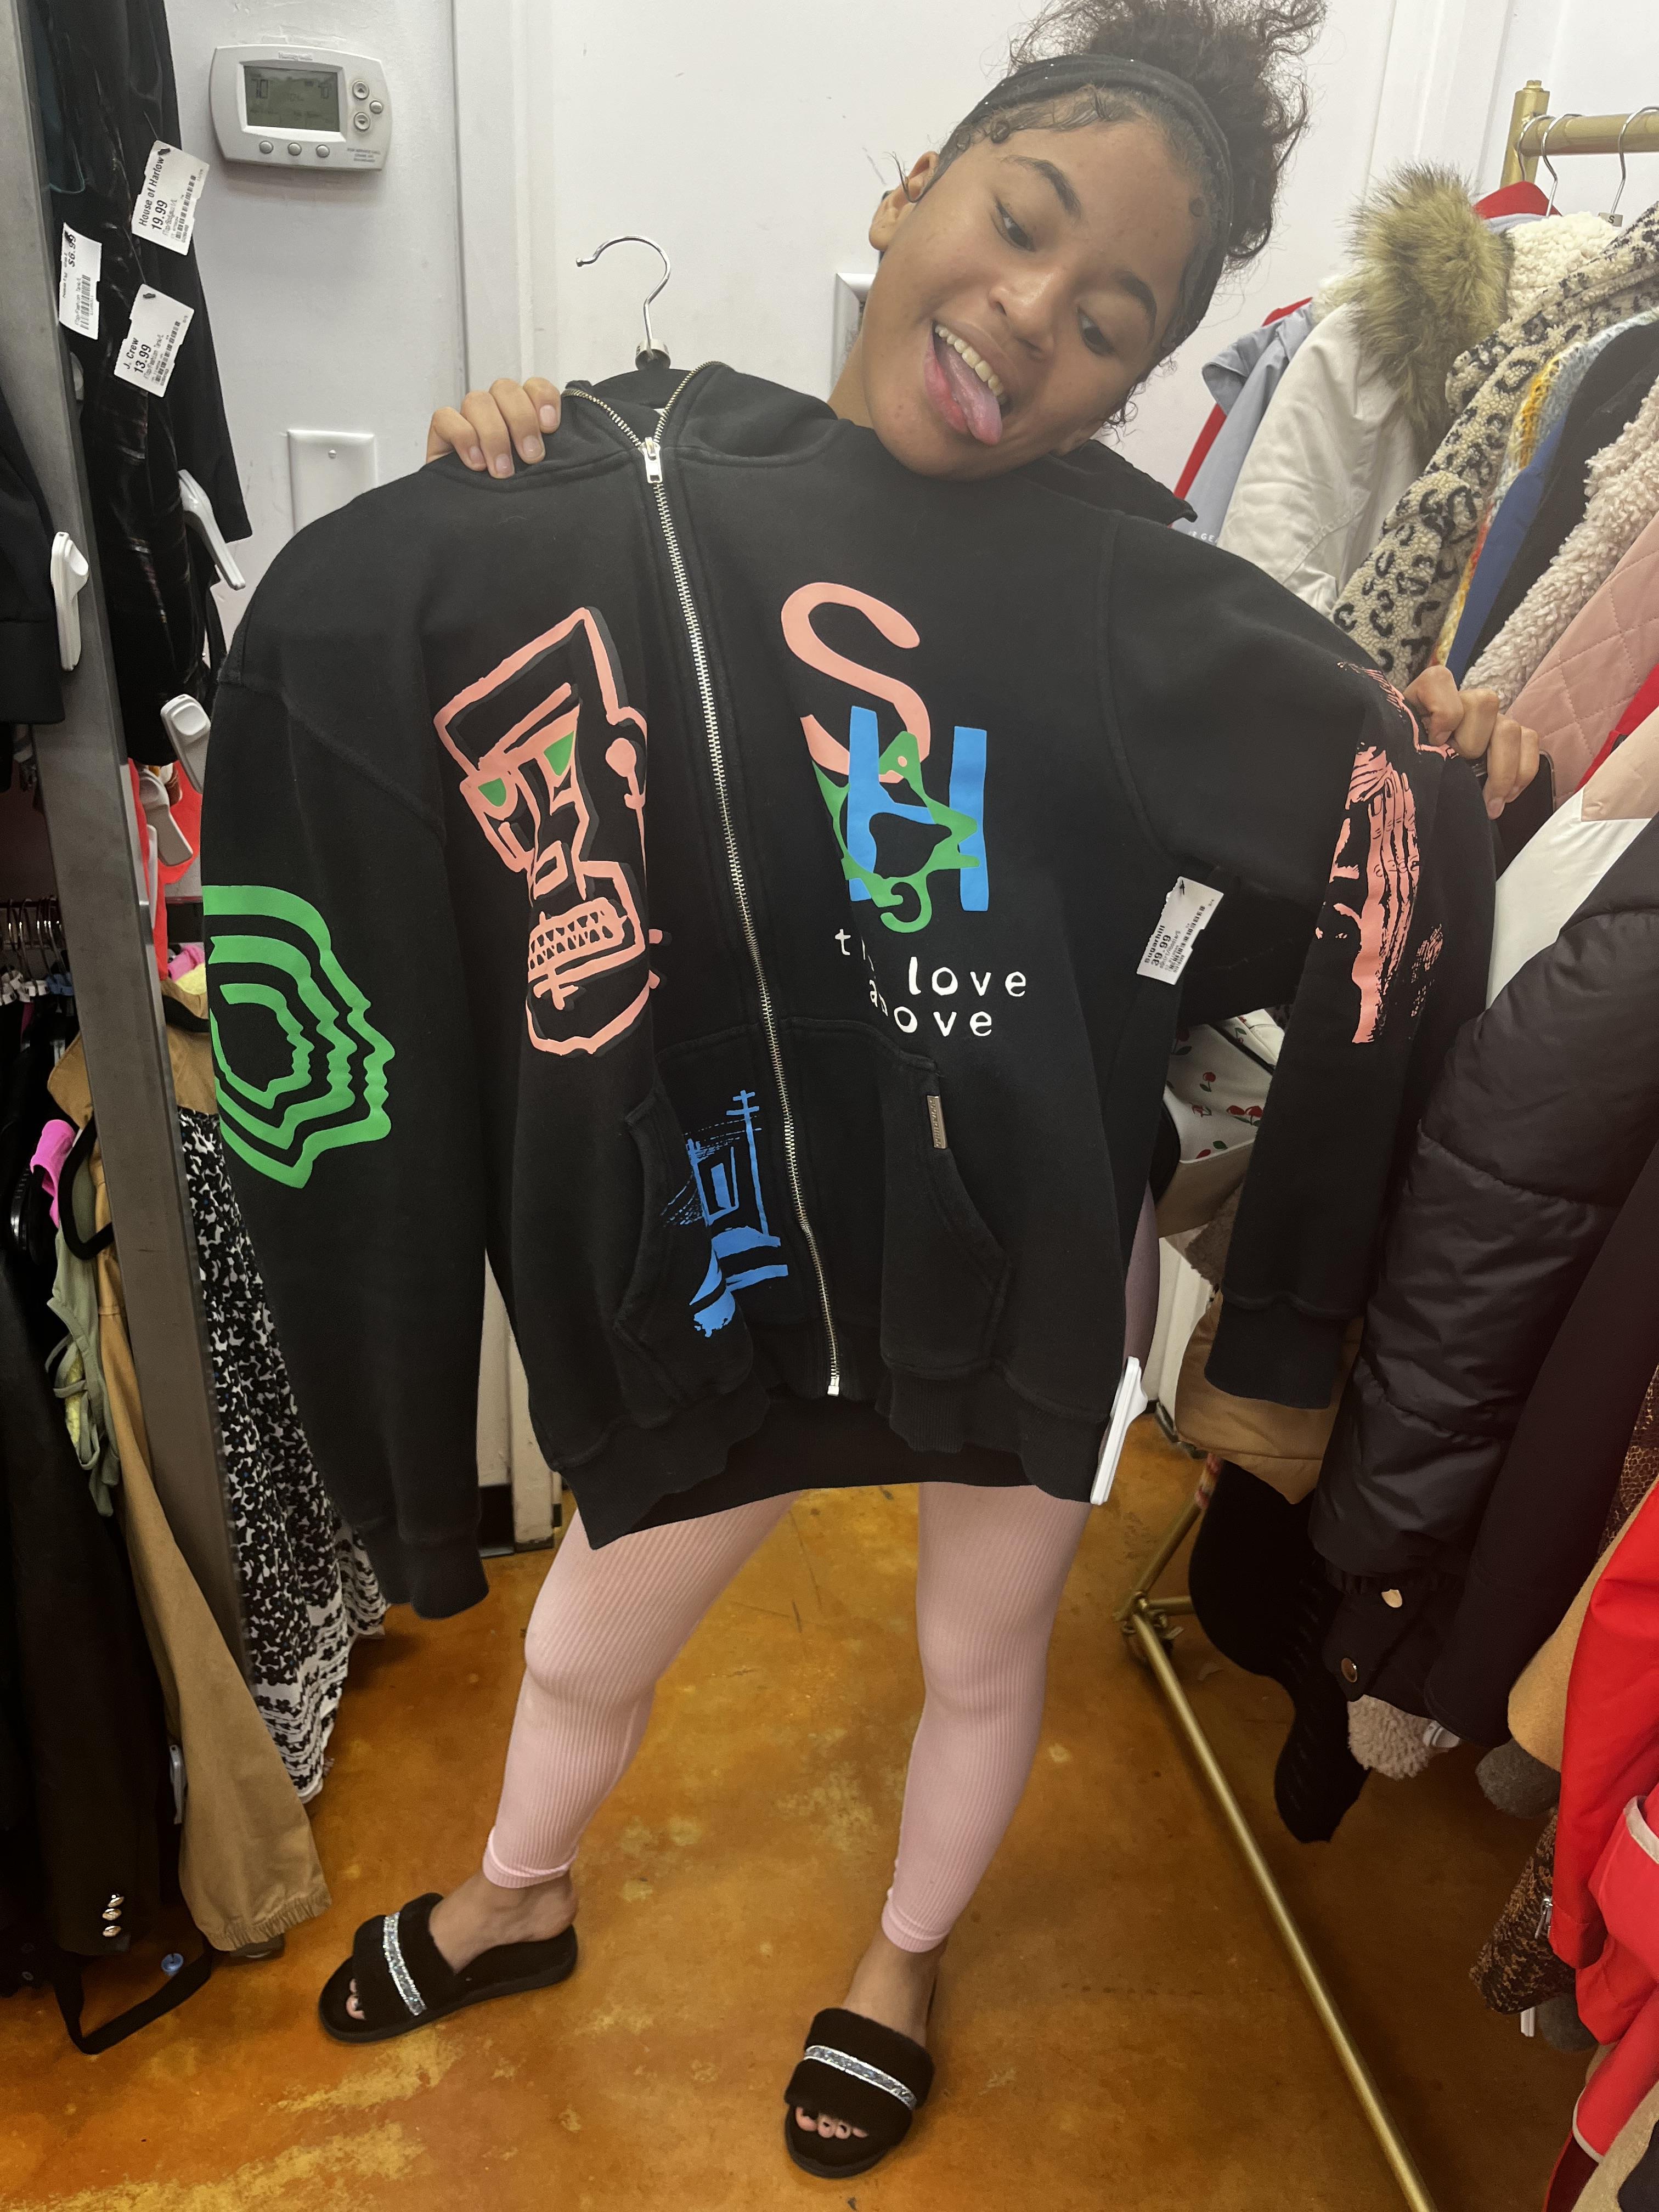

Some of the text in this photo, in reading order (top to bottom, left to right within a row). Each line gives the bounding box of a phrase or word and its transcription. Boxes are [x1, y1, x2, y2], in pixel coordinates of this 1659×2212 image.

[138, 157, 164, 226] House of Harlow
[151, 200, 168, 230] 19.99
[1608, 215, 1615, 224] S
[126, 337, 139, 359] Crew
[134, 344, 151, 373] 13.99
[1144, 925, 1165, 963] Sugarhill
[1151, 934, 1171, 966] 39.99
[909, 956, 1026, 997] love
